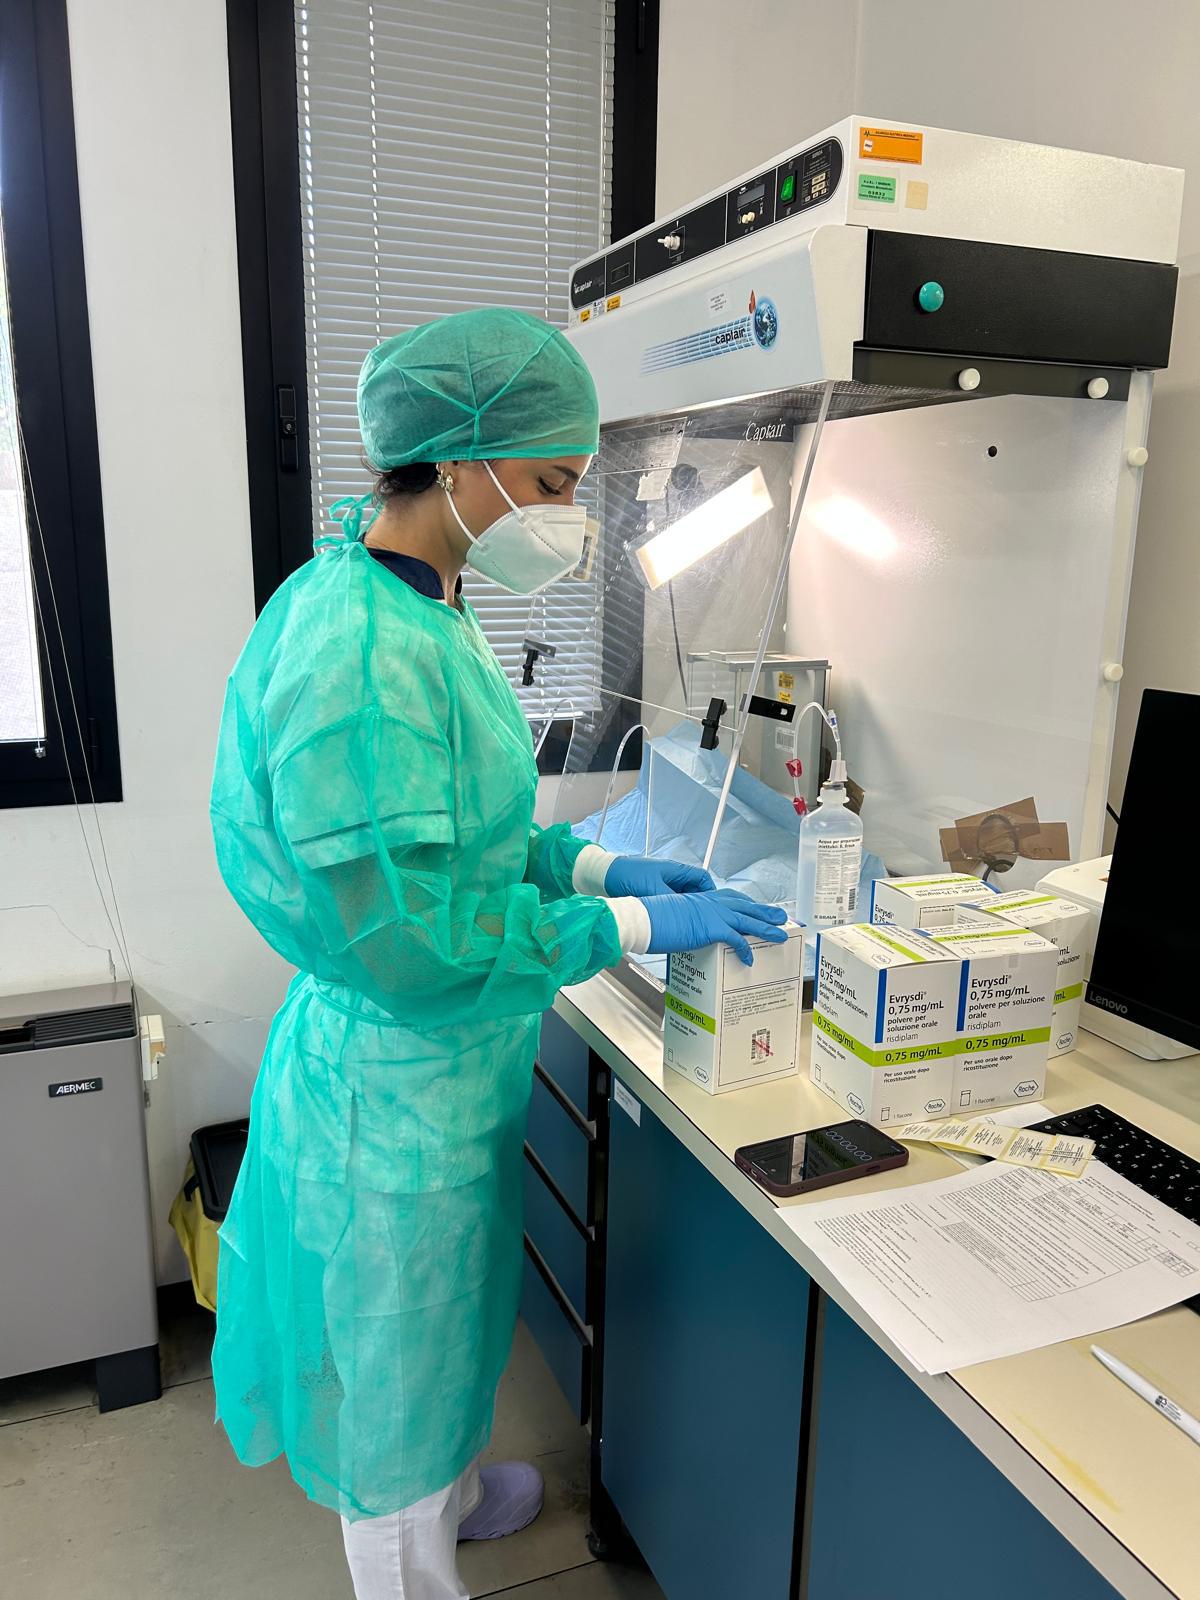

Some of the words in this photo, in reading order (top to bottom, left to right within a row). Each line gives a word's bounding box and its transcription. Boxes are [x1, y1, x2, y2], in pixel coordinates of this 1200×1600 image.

[715, 327, 746, 345] captair
[745, 418, 786, 445] Captair
[685, 964, 706, 981] mg/mL
[820, 968, 834, 984] 0,75
[834, 980, 856, 1000] mg/mL
[970, 989, 994, 1001] 0,75
[995, 984, 1030, 999] mg/mL
[888, 1004, 910, 1016] 0,75
[912, 1000, 944, 1014] mg/mL
[968, 1002, 996, 1012] polvere
[998, 1000, 1010, 1009] per
[1012, 996, 1046, 1006] soluzione
[1089, 990, 1128, 1014] Lenovo
[684, 1008, 706, 1026] mg/mL
[888, 1016, 914, 1026] polvere
[968, 1011, 987, 1020] orale
[818, 1016, 830, 1032] 0,75
[832, 1028, 854, 1050] mg/mL
[888, 1024, 920, 1032] soluzione
[922, 1020, 938, 1028] orale
[968, 1020, 1002, 1030] risdiplam
[886, 1033, 918, 1042] risdiplam
[966, 1038, 989, 1050] 0,75
[992, 1033, 1026, 1048] mg/mL
[886, 1052, 907, 1062] 0,75
[910, 1046, 942, 1060] mg/mL
[56, 1082, 96, 1095] AERMEC
[1018, 1084, 1036, 1093] Roche
